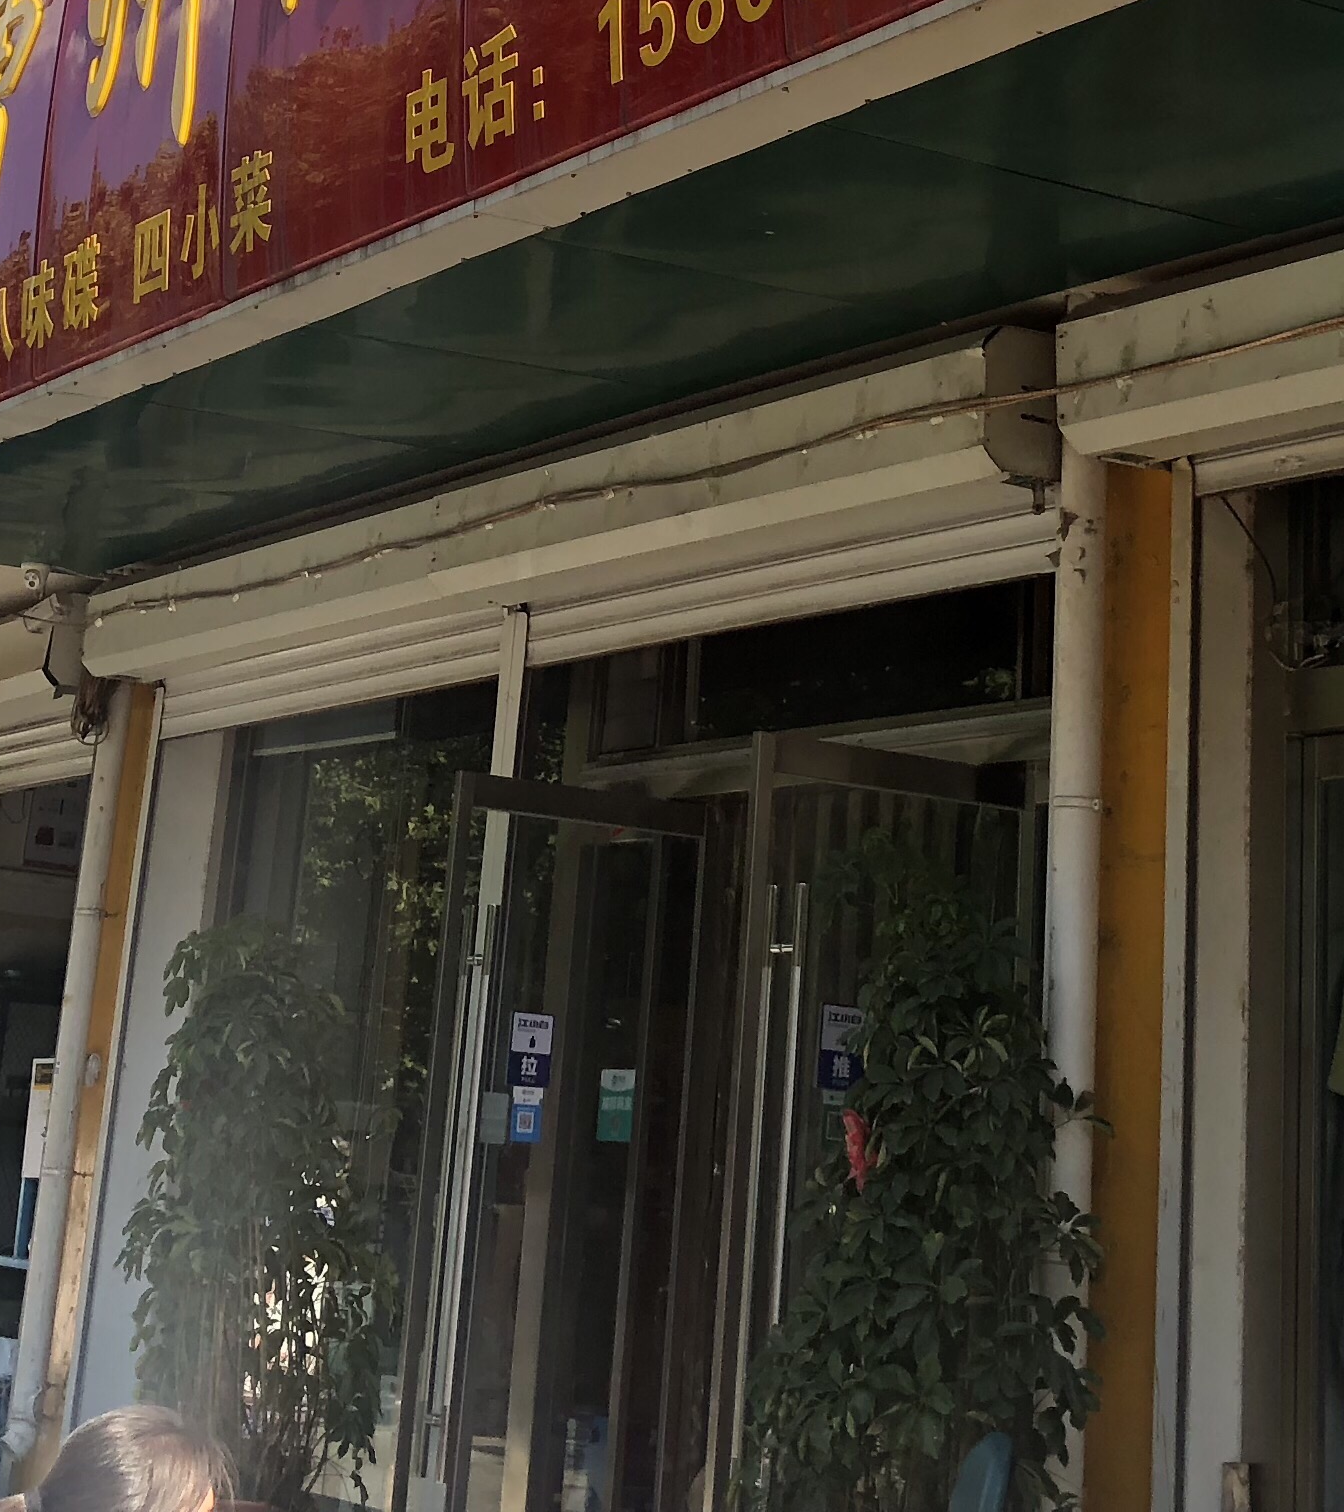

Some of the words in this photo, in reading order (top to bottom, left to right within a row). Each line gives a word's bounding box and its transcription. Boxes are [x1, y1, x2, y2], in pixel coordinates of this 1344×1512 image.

[132, 149, 273, 305] 四小菜
[521, 1055, 538, 1076] 拉
[832, 1054, 850, 1078] 推
